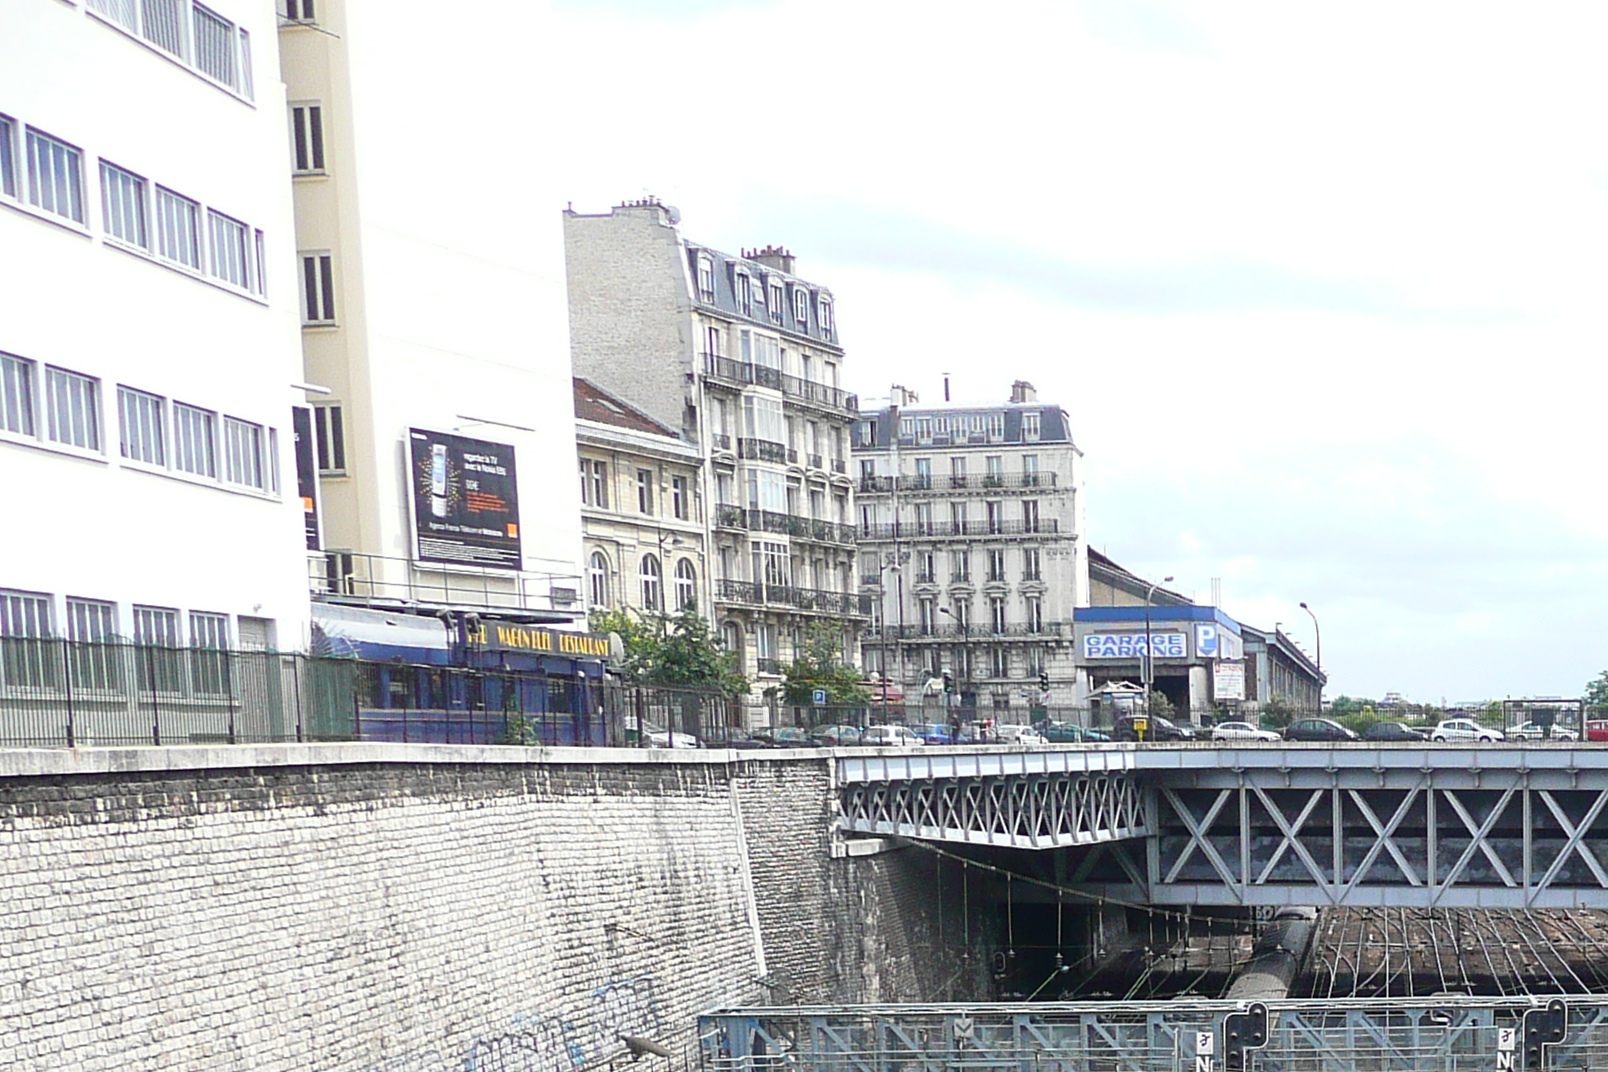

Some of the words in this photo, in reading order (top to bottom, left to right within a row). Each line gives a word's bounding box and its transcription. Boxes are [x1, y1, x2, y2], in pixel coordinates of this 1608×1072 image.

[497, 626, 531, 649] WAGON
[559, 633, 609, 656] RESTAURANT
[1086, 635, 1182, 646] GARAGE
[1087, 645, 1184, 657] PARKNG
